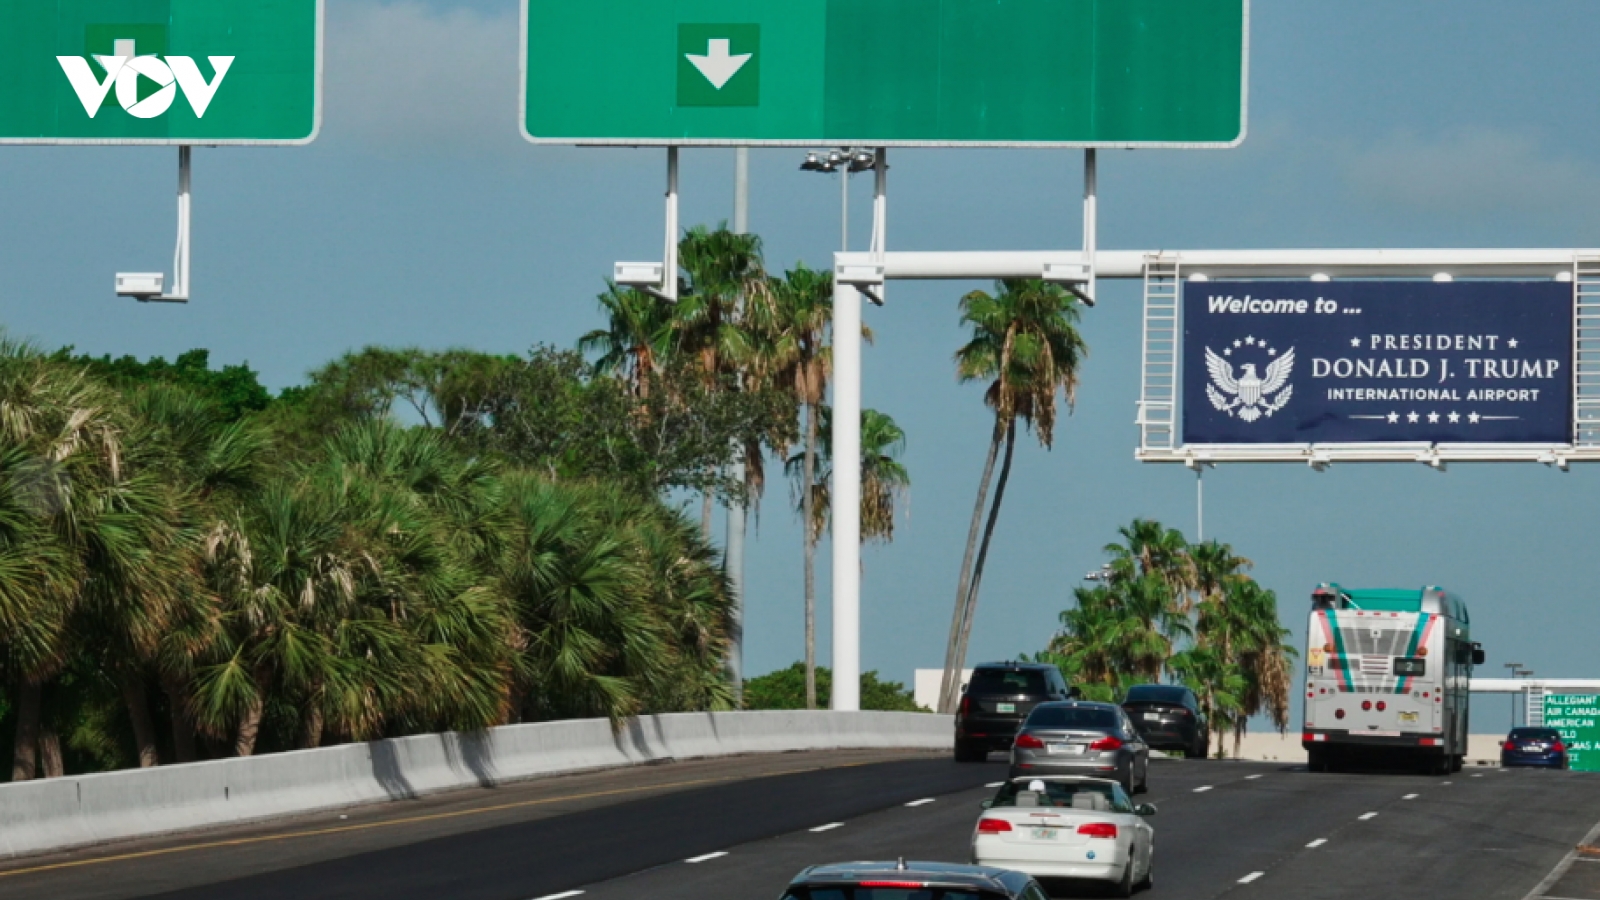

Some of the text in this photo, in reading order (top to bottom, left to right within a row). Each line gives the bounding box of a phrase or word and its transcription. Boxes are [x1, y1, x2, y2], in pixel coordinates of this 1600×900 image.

[1208, 294, 1308, 314] Welcome
[1313, 296, 1338, 314] to
[1371, 333, 1499, 351] PRESIDENT
[1311, 357, 1560, 384] DONALD J. TRUMP
[1327, 387, 1540, 402] INTERNATIONAL AIRPORT
[1546, 695, 1597, 705] ALLEGIANT
[1546, 707, 1600, 716] AIR CANAD
[1546, 718, 1595, 728] AMERICAN
